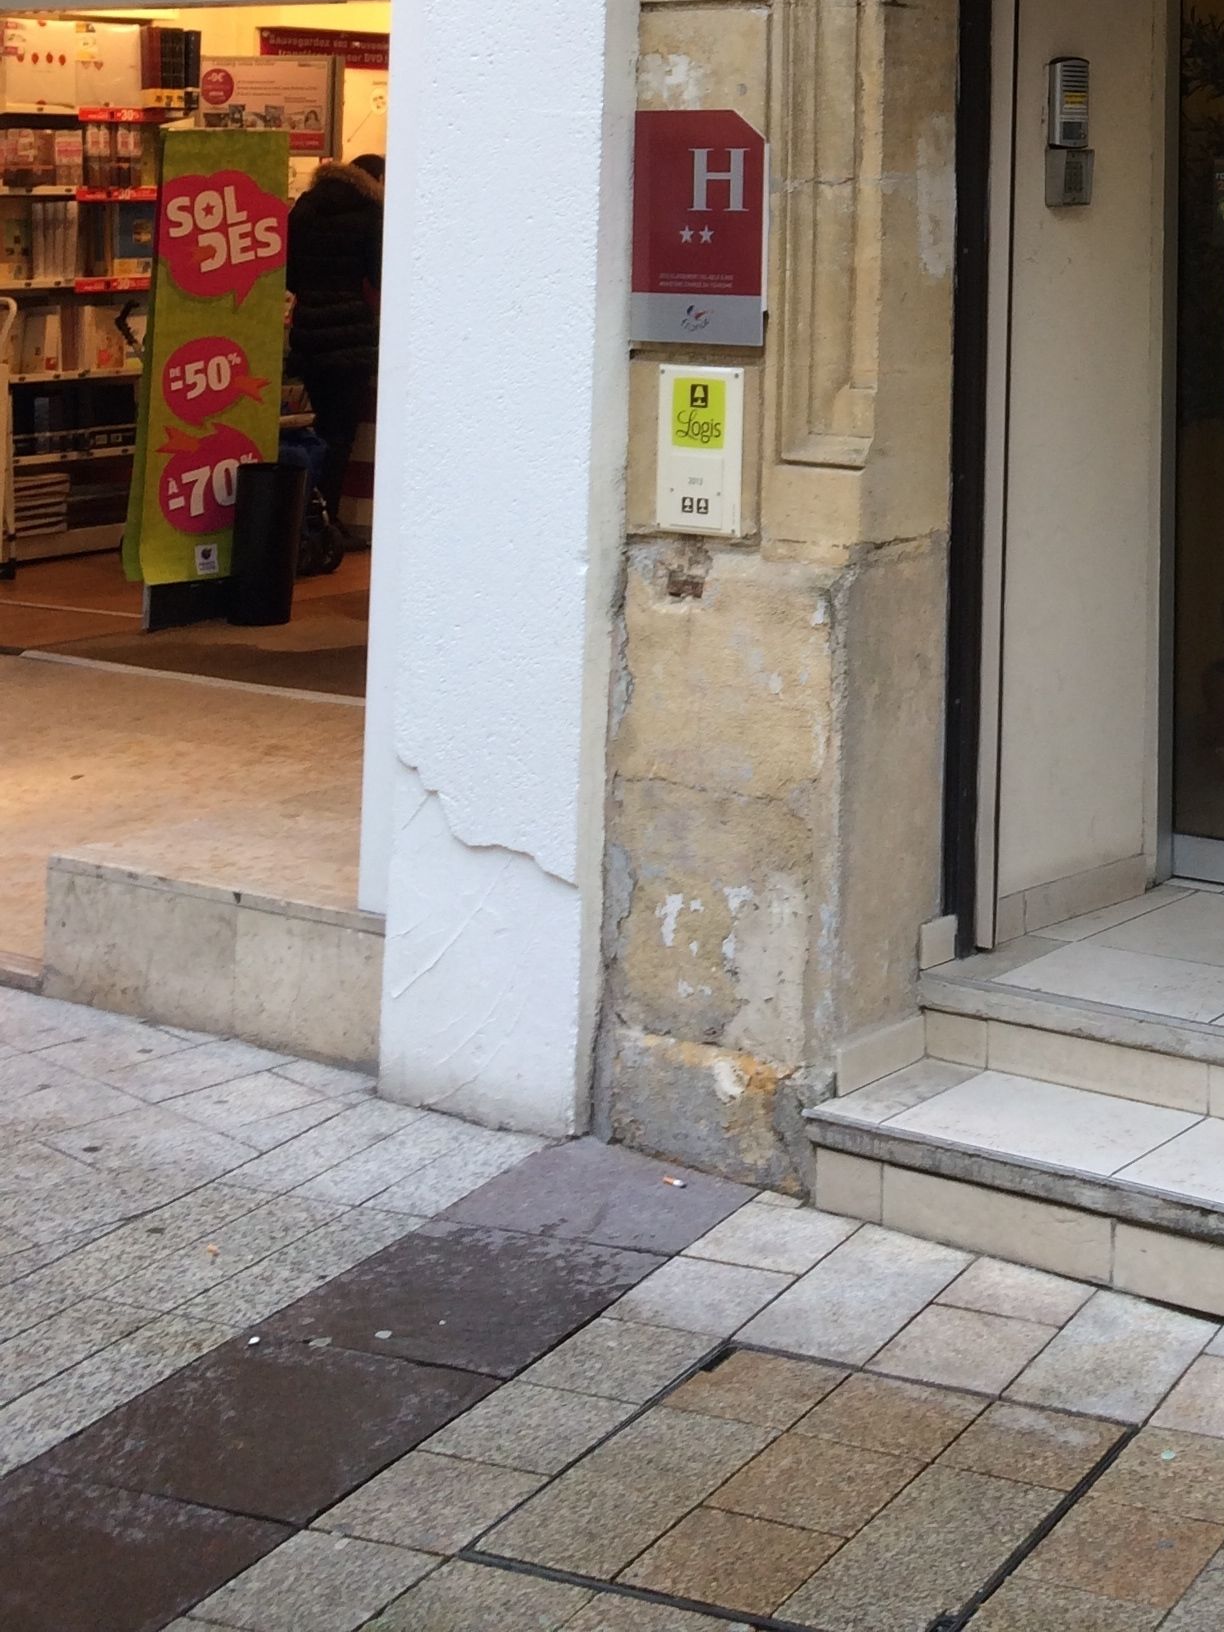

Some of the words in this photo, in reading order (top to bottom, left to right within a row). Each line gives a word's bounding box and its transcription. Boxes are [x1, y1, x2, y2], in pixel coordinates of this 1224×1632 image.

[687, 147, 751, 212] H
[166, 185, 248, 238] SOL
[197, 217, 282, 273] DES
[675, 409, 722, 444] Logis
